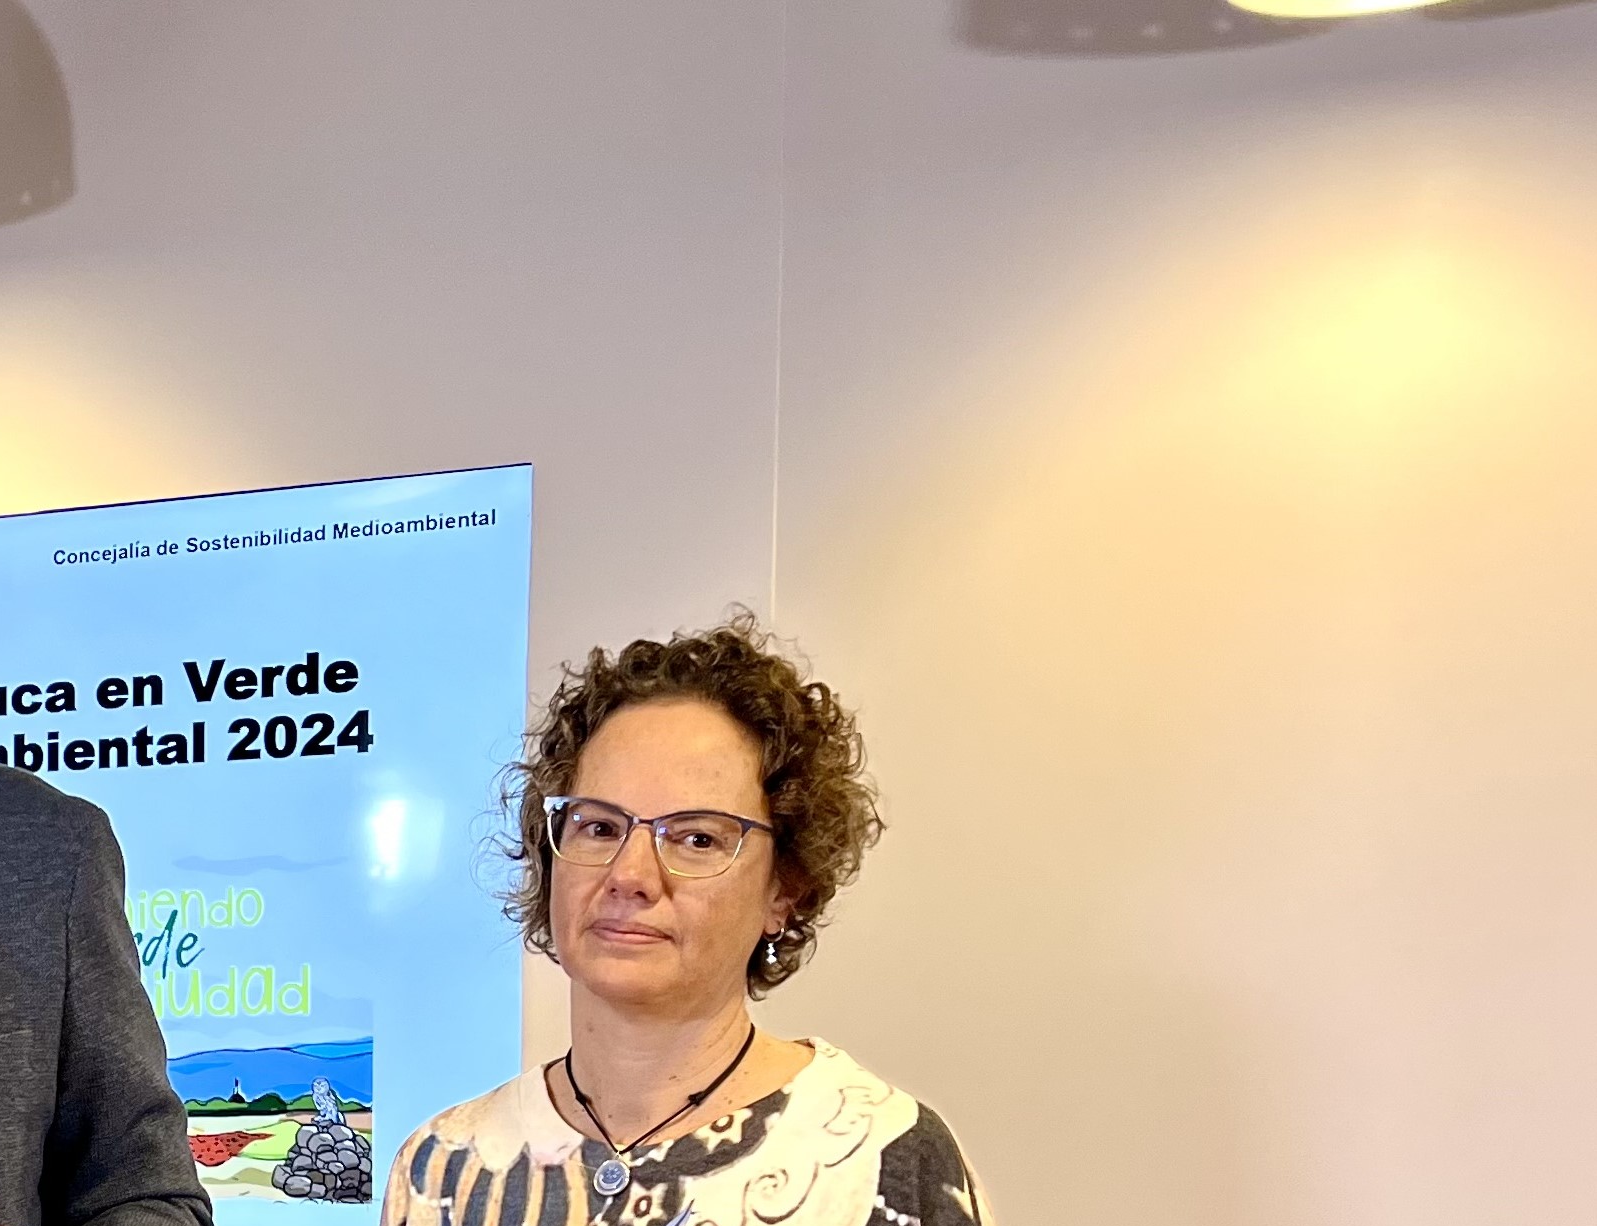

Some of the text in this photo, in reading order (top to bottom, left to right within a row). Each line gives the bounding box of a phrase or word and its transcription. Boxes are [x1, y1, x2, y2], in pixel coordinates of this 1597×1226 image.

[53, 508, 497, 565] Concejalía de Sostenibilidad Medioambiental
[96, 674, 163, 709] en
[183, 652, 359, 704] Verde
[226, 709, 375, 762] 2024
[154, 964, 310, 1017] iudad
